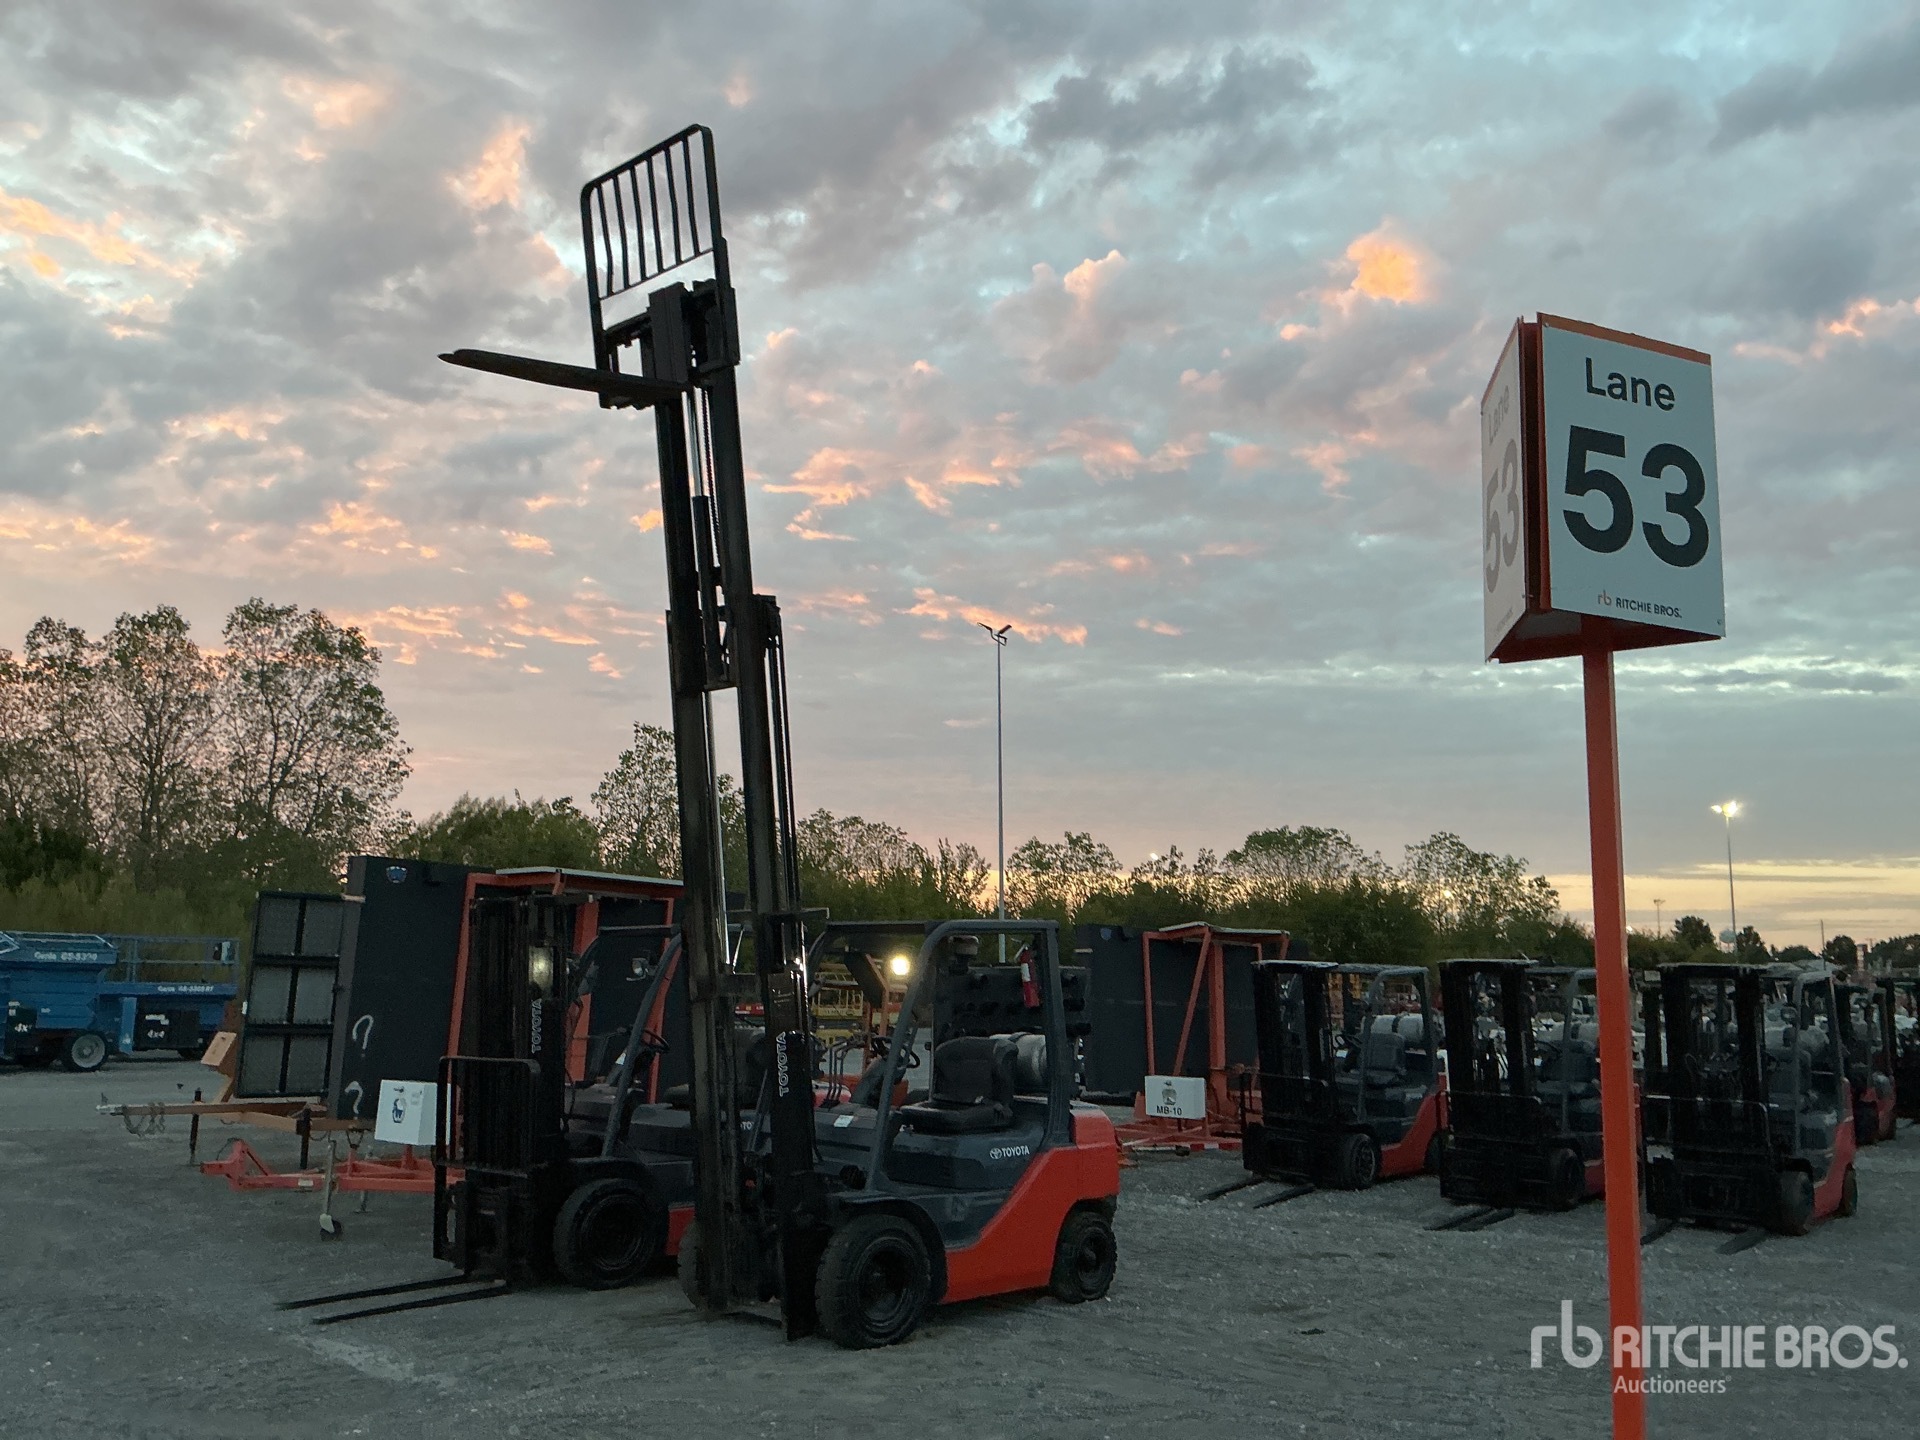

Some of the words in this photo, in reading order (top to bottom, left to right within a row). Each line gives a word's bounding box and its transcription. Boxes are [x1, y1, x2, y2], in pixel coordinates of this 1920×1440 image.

[1585, 357, 1676, 412] Lane
[1486, 439, 1520, 594] 53
[1563, 425, 1709, 568] 53
[1616, 596, 1653, 614] RITCHIE
[531, 998, 542, 1054] TOYOTA
[776, 1031, 790, 1097] TOYOTA
[1156, 1105, 1183, 1116] MB-10
[1001, 1145, 1030, 1157] TOYOTA
